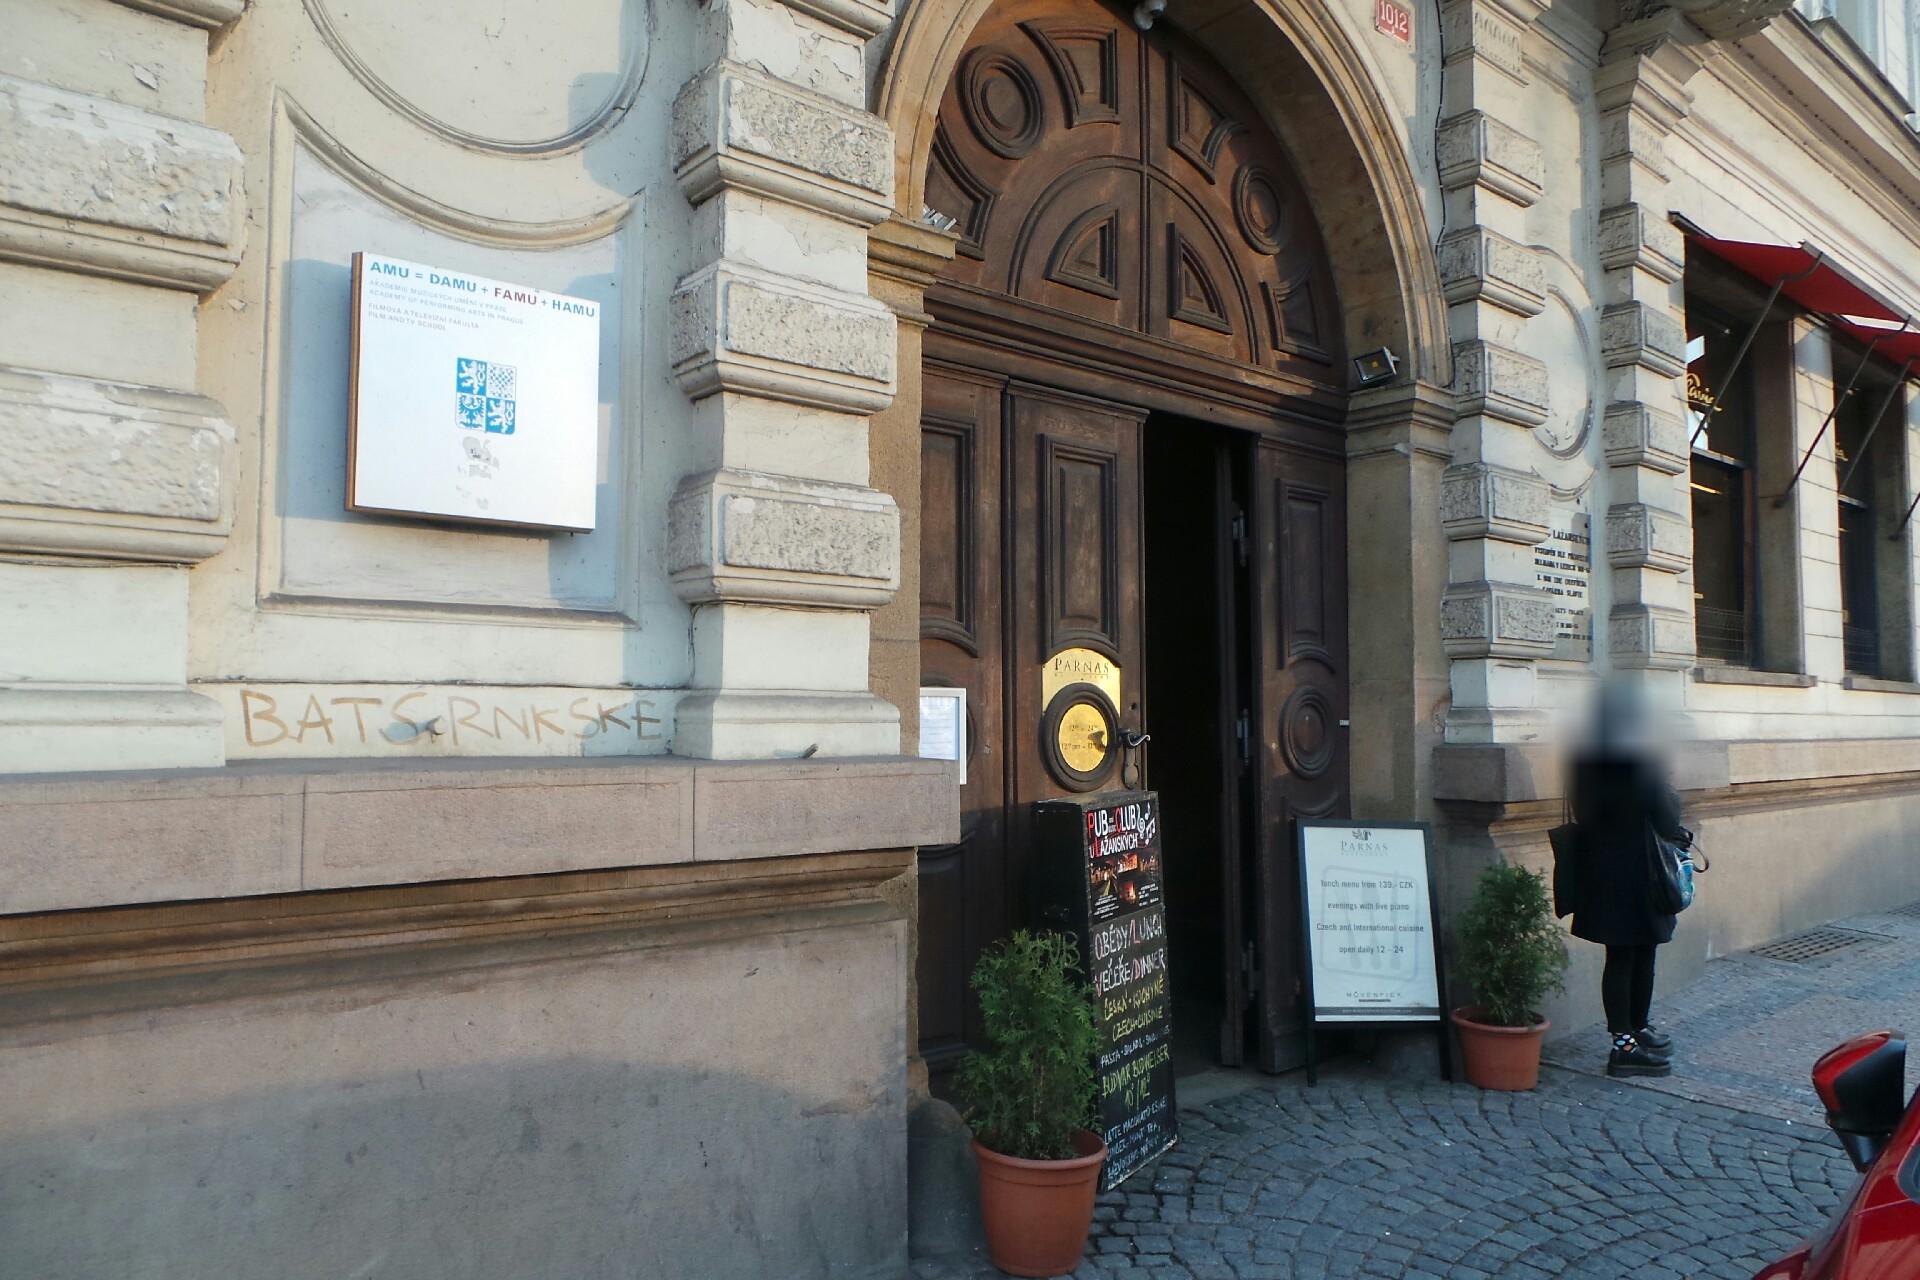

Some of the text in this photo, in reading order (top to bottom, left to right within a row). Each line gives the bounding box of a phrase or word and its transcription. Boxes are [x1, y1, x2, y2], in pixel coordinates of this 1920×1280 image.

[1380, 1, 1408, 33] 1012
[370, 261, 409, 279] AMU
[429, 273, 477, 293] DAMU
[494, 287, 537, 306] FAMU
[552, 299, 595, 318] HAMU
[369, 288, 406, 301] ACADEMY
[468, 308, 486, 318] ARTS
[368, 311, 386, 321] FILM
[417, 320, 447, 332] SCHOOL
[1054, 657, 1110, 674] PARNAS
[1087, 809, 1109, 838] PUB
[1115, 804, 1137, 832] CLUB
[1095, 831, 1139, 858] LAŽANSKÝCH
[1341, 839, 1389, 852] PARNAS
[1320, 879, 1340, 888] lunch
[1341, 880, 1360, 889] menu
[1361, 879, 1377, 889] from
[1399, 881, 1414, 889] CZK
[1327, 902, 1410, 912] evenings with live piano
[1316, 922, 1338, 931] Czech
[1339, 923, 1352, 931] and
[1398, 924, 1425, 933] cuisine
[1338, 945, 1356, 955] open
[1357, 945, 1375, 955] daily
[1376, 945, 1385, 954] 12
[1393, 945, 1405, 954] 24
